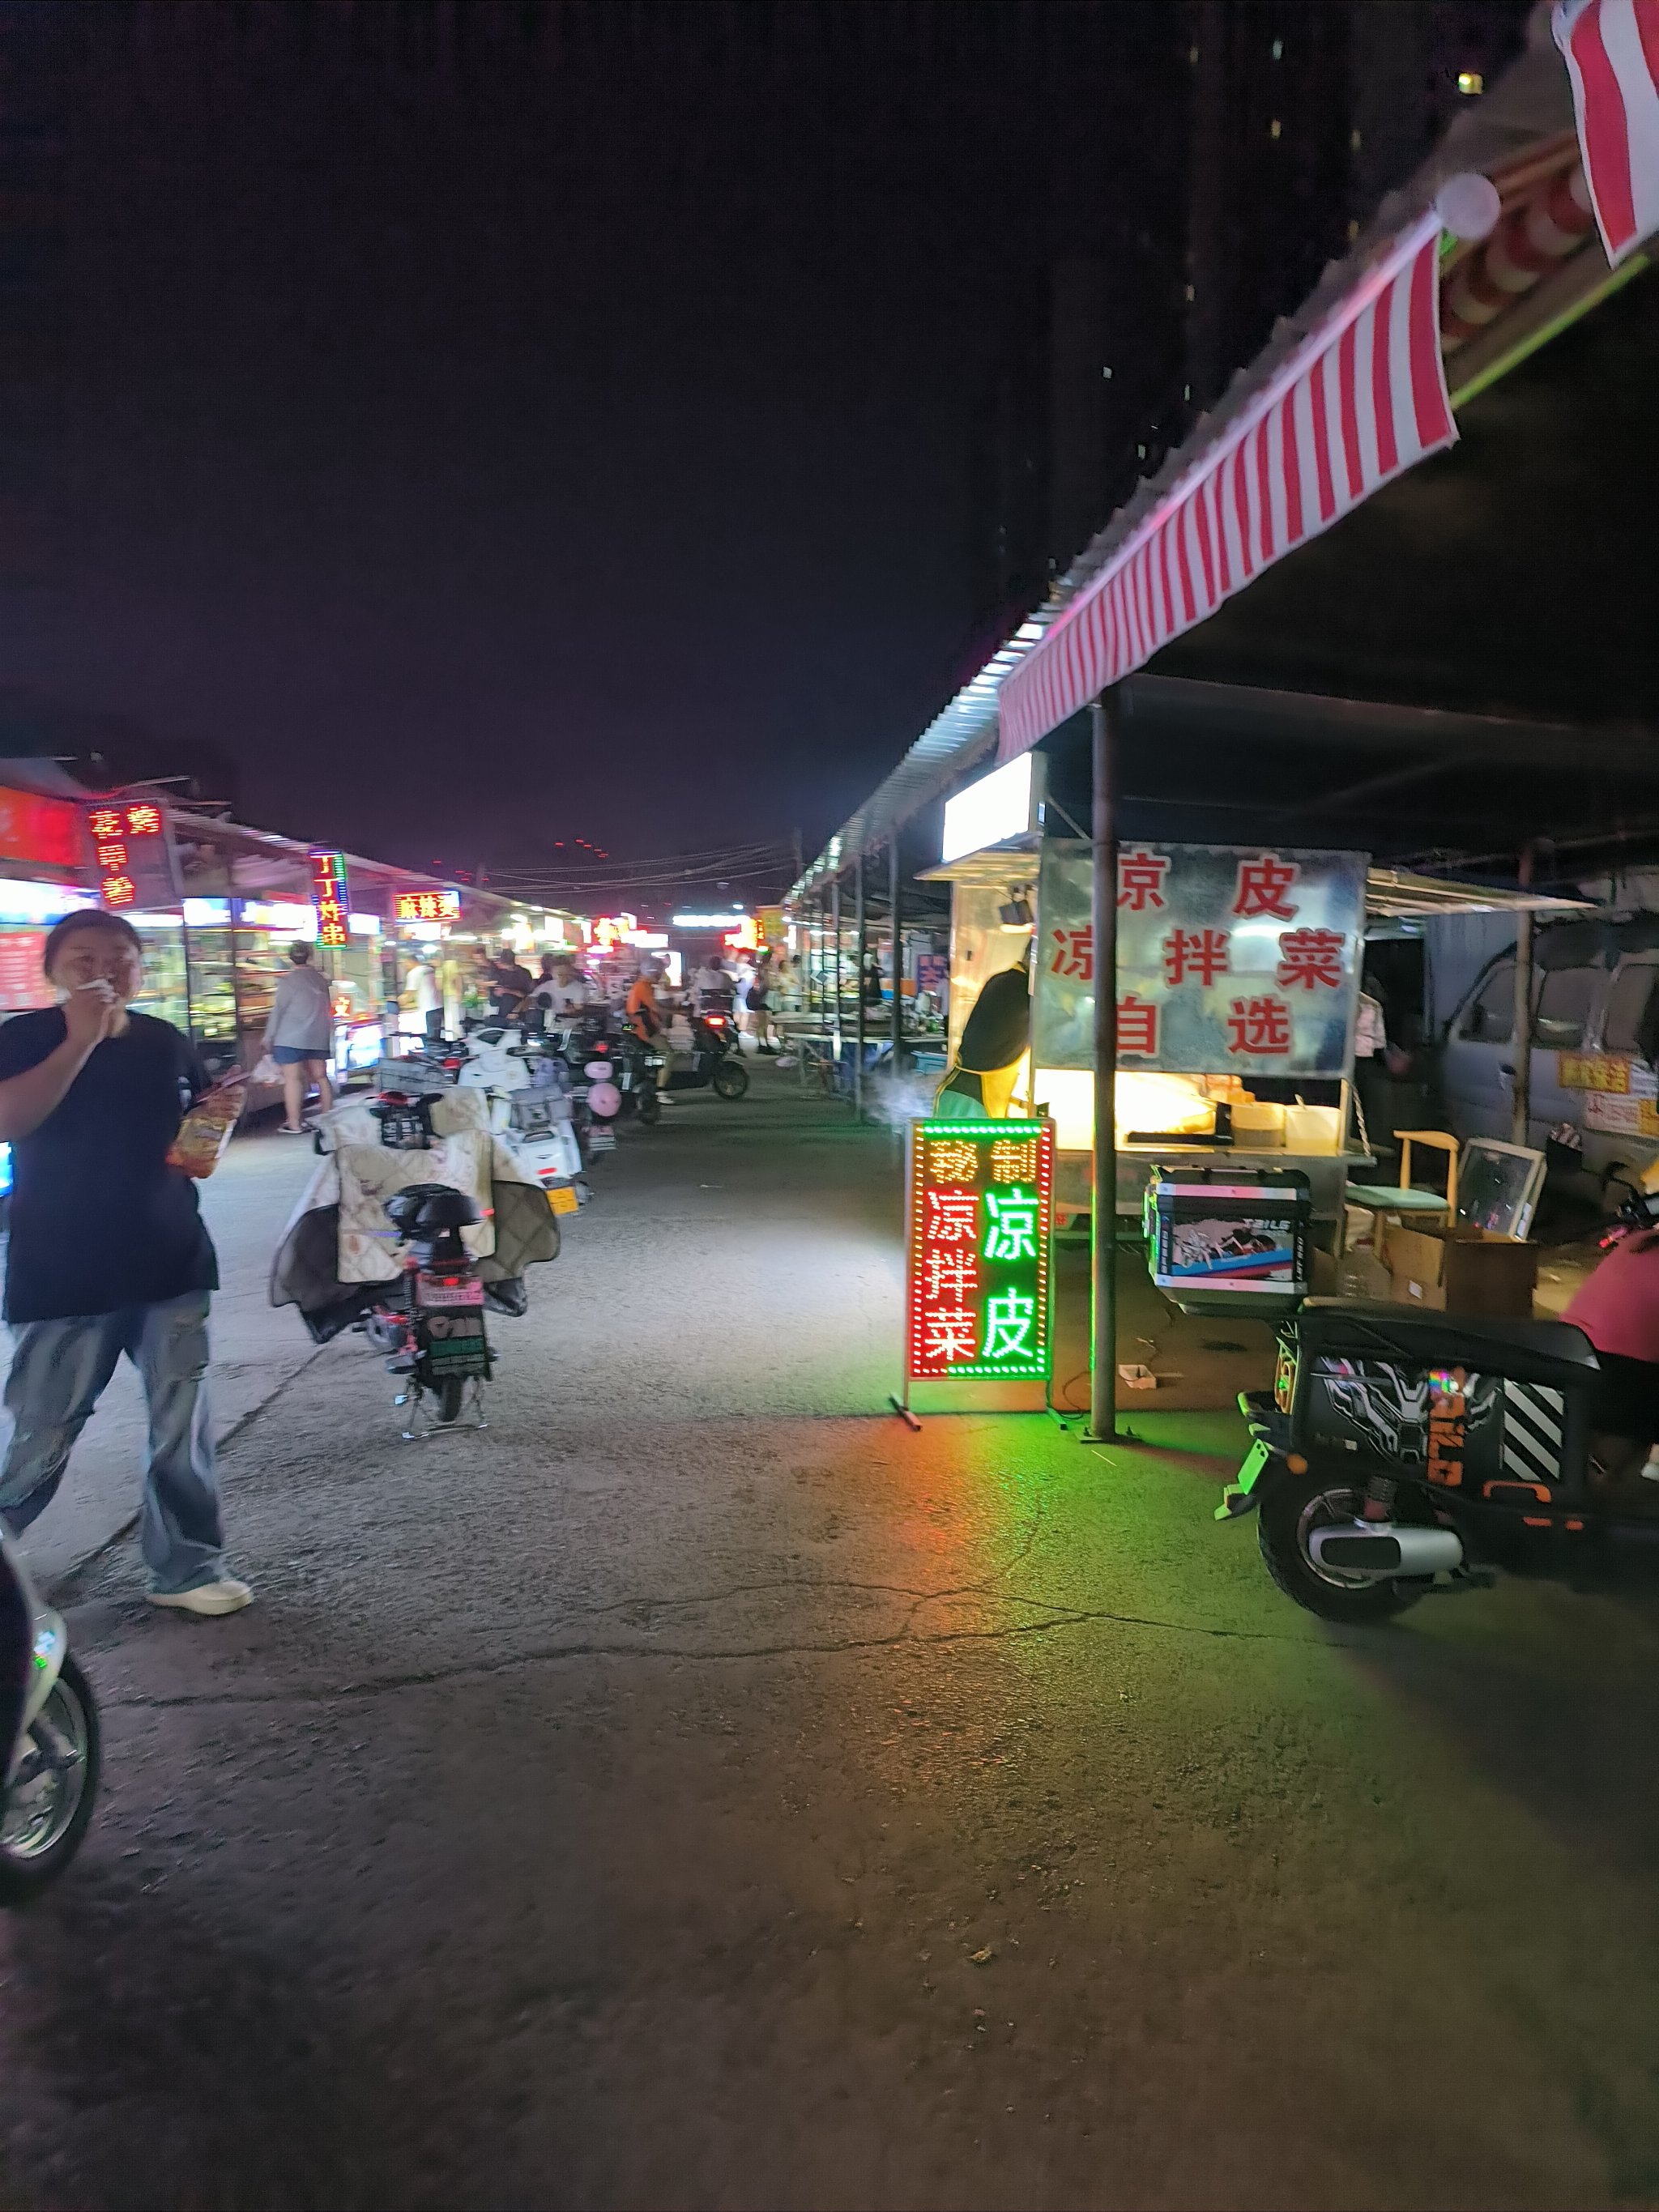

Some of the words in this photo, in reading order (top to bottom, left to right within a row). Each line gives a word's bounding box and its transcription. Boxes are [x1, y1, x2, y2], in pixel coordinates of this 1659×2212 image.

[1051, 926, 1346, 991] 凉拌菜
[925, 1190, 979, 1361] 凉拌菜
[983, 1188, 1039, 1357] 凉皮
